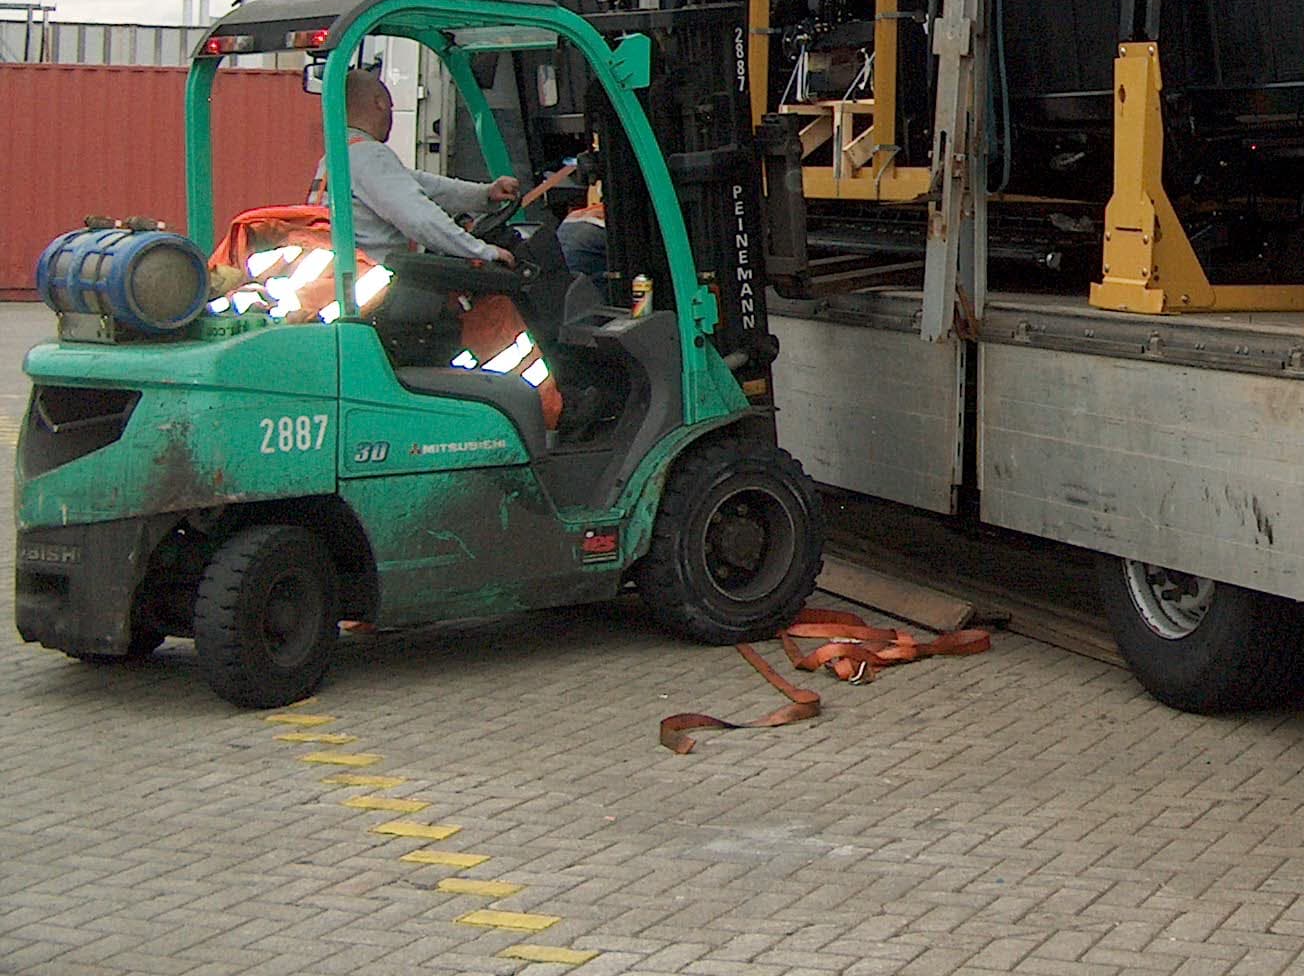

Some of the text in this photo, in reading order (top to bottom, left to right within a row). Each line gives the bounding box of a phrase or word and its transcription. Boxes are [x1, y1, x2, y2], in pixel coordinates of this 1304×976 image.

[734, 27, 746, 92] 2887
[732, 185, 756, 330] PEINEMANN
[259, 415, 329, 454] 2887
[354, 441, 389, 463] 30
[422, 439, 506, 455] MITSUBISHI
